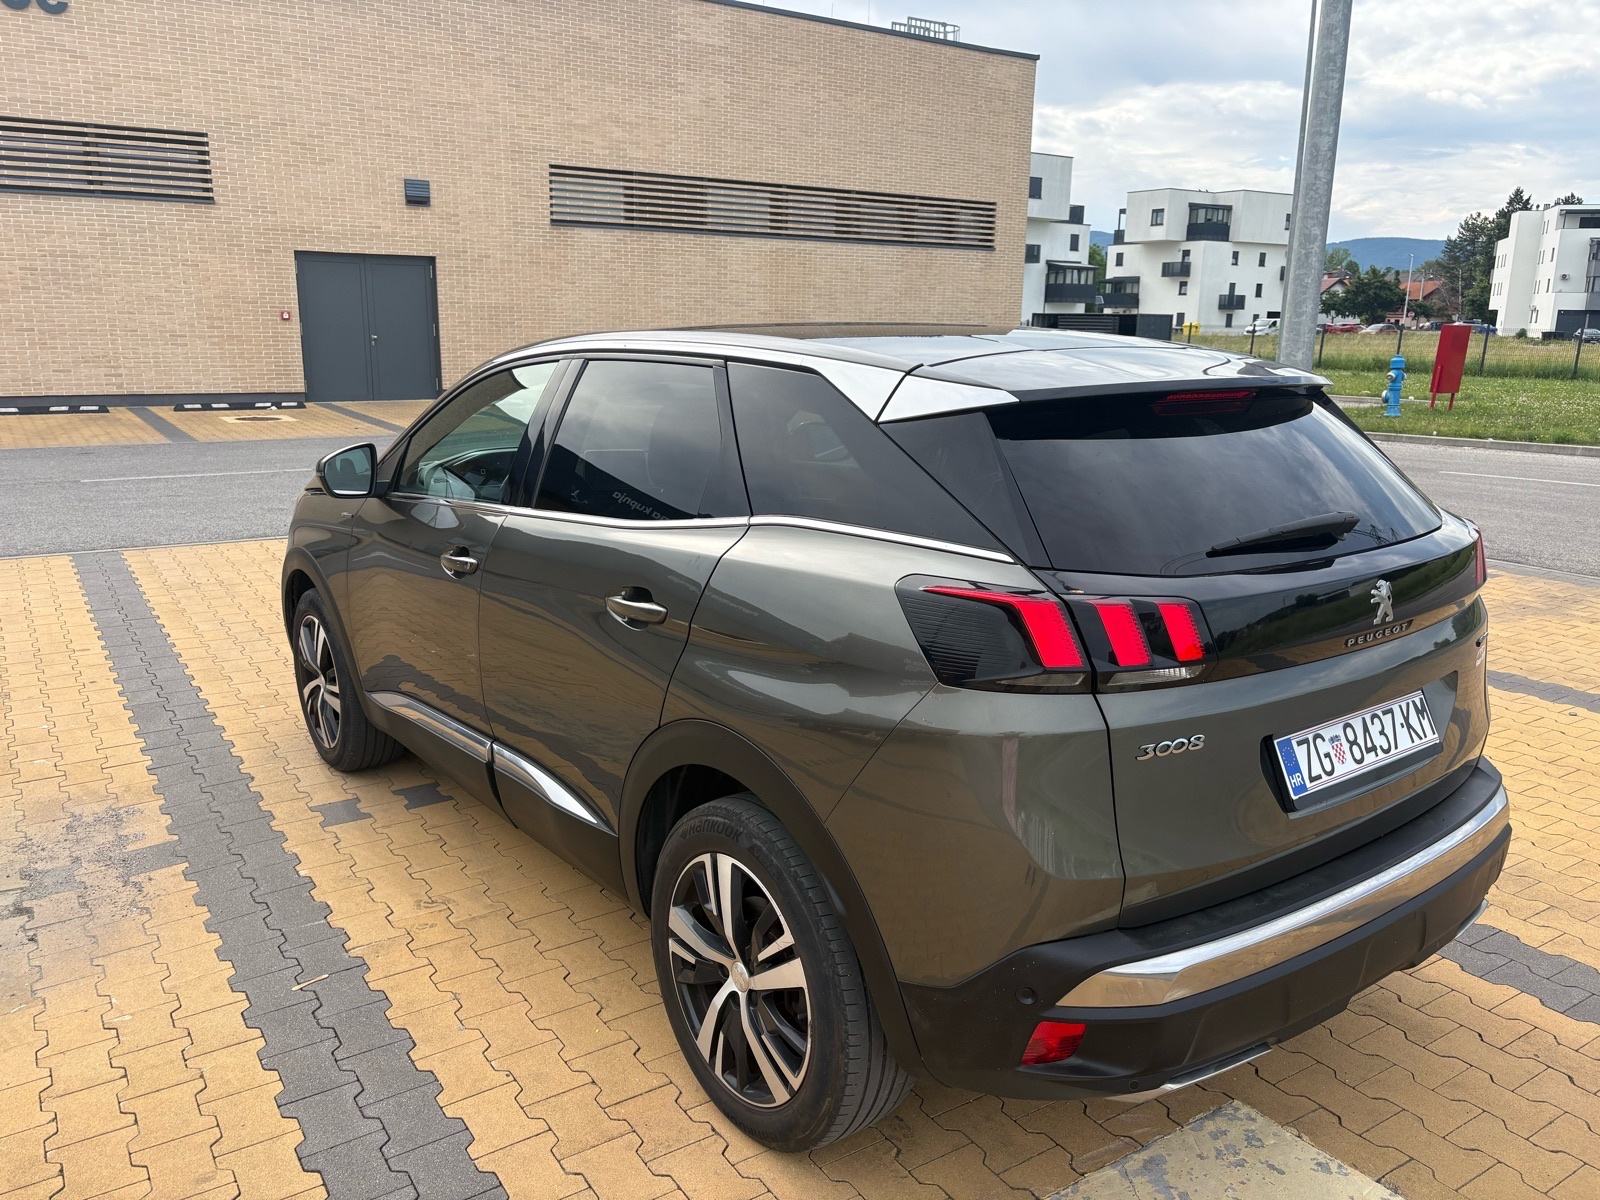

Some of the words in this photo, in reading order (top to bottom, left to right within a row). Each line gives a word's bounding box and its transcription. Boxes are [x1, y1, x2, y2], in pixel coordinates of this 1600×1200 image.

[1346, 622, 1409, 647] PEUGEOT
[1136, 734, 1206, 761] 3008
[1296, 732, 1335, 784] ZG
[1289, 772, 1304, 788] HR
